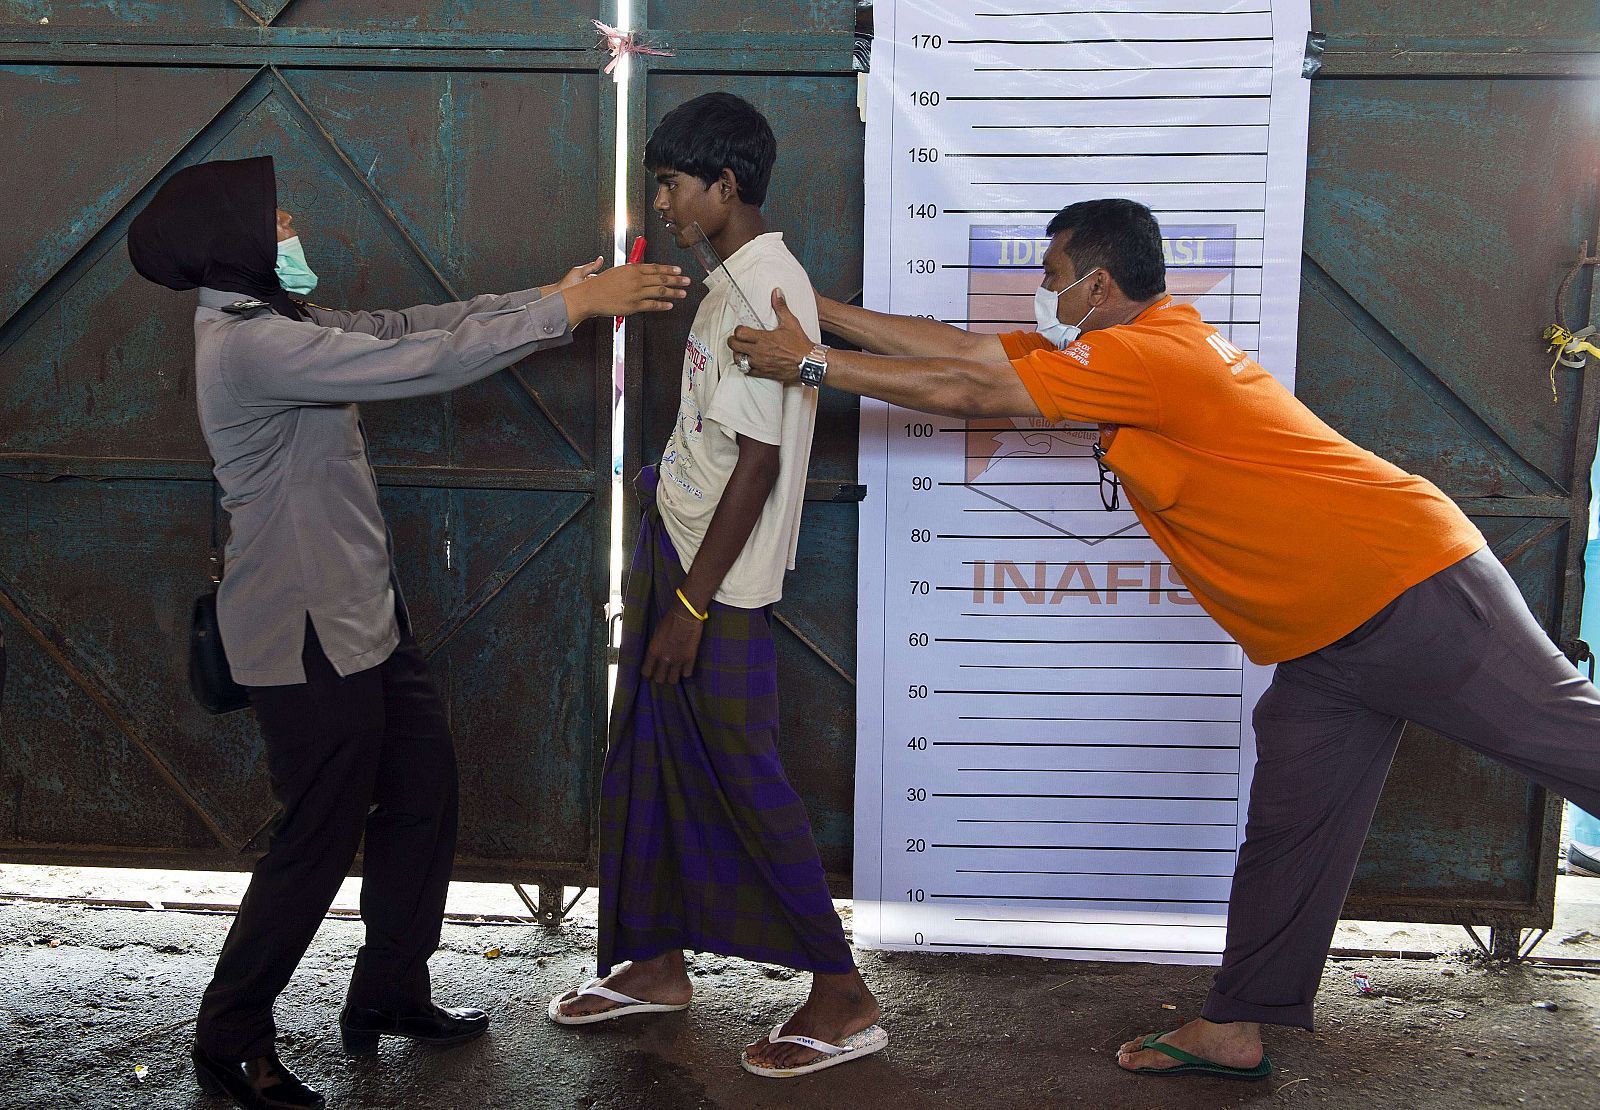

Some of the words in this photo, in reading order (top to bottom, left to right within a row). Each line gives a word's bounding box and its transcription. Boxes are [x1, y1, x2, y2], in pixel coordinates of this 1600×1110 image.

[912, 35, 941, 48] 170
[911, 92, 939, 106] 160
[909, 148, 937, 162] 150
[908, 204, 936, 218] 140
[907, 260, 935, 273] 130
[905, 424, 933, 437] 100
[913, 477, 931, 490] 90
[911, 529, 930, 542] 80
[911, 581, 929, 594] 70
[909, 633, 928, 646] 60
[909, 685, 927, 698] 50
[908, 737, 926, 750] 40
[907, 788, 926, 801] 30
[906, 839, 925, 852] 20
[907, 889, 924, 902] 10
[914, 933, 923, 945] 0
